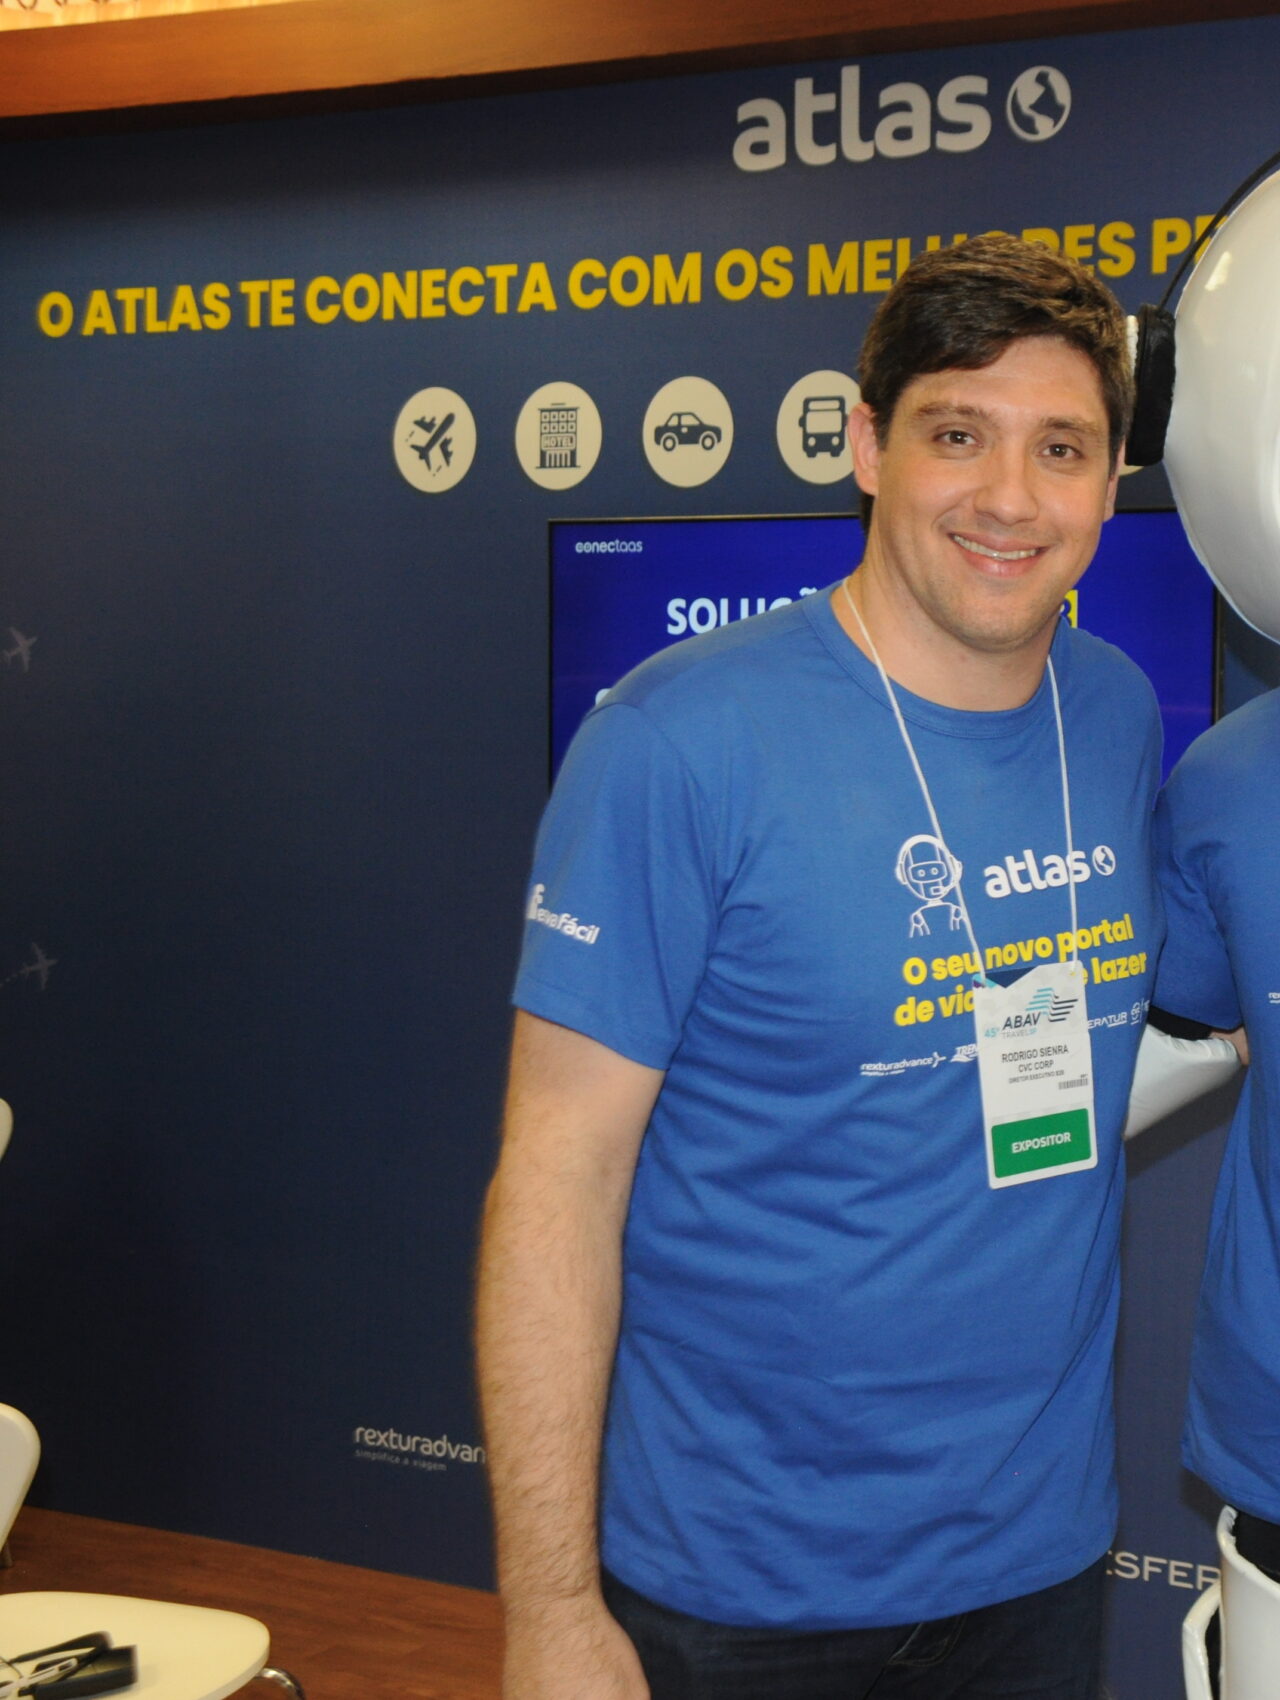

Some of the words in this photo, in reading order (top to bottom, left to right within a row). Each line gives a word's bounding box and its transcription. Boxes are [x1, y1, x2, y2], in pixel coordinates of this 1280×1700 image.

[733, 65, 992, 172] atlas
[37, 291, 74, 338] O
[82, 282, 232, 336] ATLAS
[239, 278, 295, 328] TE
[305, 262, 557, 325] CONECTA
[568, 251, 702, 310] COM
[714, 248, 795, 301] OS
[807, 221, 1136, 297] MELES
[983, 849, 1091, 899] atlas
[902, 957, 927, 985] O
[931, 950, 982, 981] seu
[985, 936, 1053, 970] novo
[1057, 913, 1135, 963] portal
[893, 996, 935, 1027] de
[1091, 951, 1148, 985] lazer
[1002, 1011, 1042, 1030] ABAV
[1001, 1048, 1038, 1063] RODRIGO
[1040, 1044, 1069, 1058] SIENRA
[1018, 1063, 1033, 1073] CVC
[1034, 1060, 1054, 1071] CORP
[1011, 1132, 1071, 1154] EXPOSITOR
[1106, 1550, 1221, 1591] SFER
